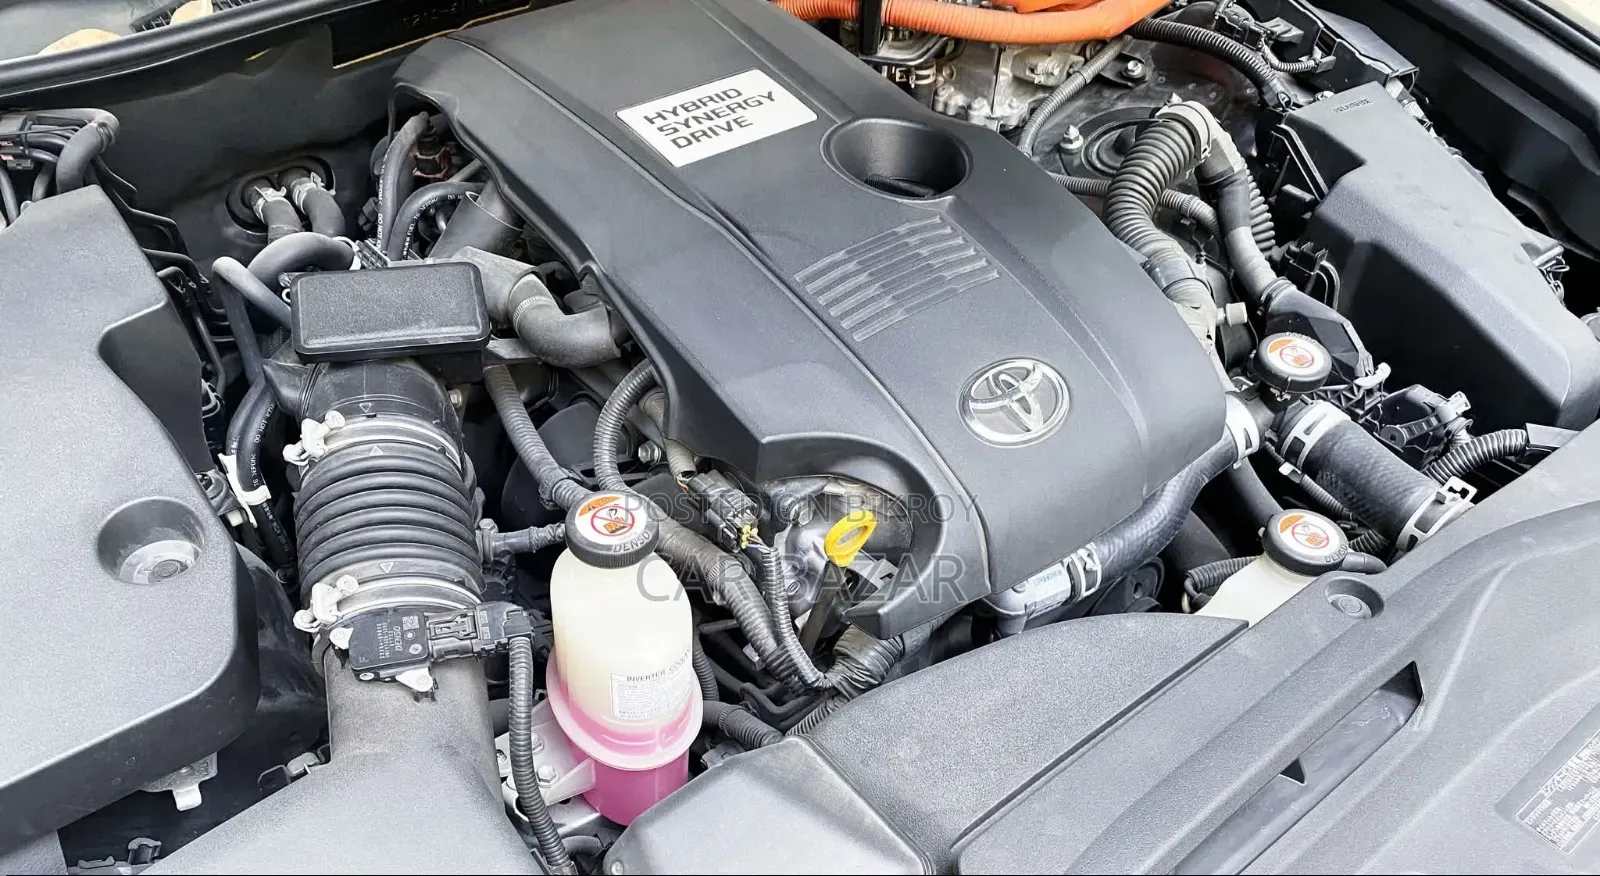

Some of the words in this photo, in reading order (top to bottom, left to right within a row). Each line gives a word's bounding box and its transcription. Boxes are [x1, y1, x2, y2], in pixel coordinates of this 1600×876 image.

[643, 88, 743, 125] HYBRID
[657, 91, 775, 136] SYNERGY
[670, 115, 753, 149] DRIVE
[253, 434, 261, 444] DO
[259, 420, 268, 433] NOT
[613, 531, 652, 554] DENSO
